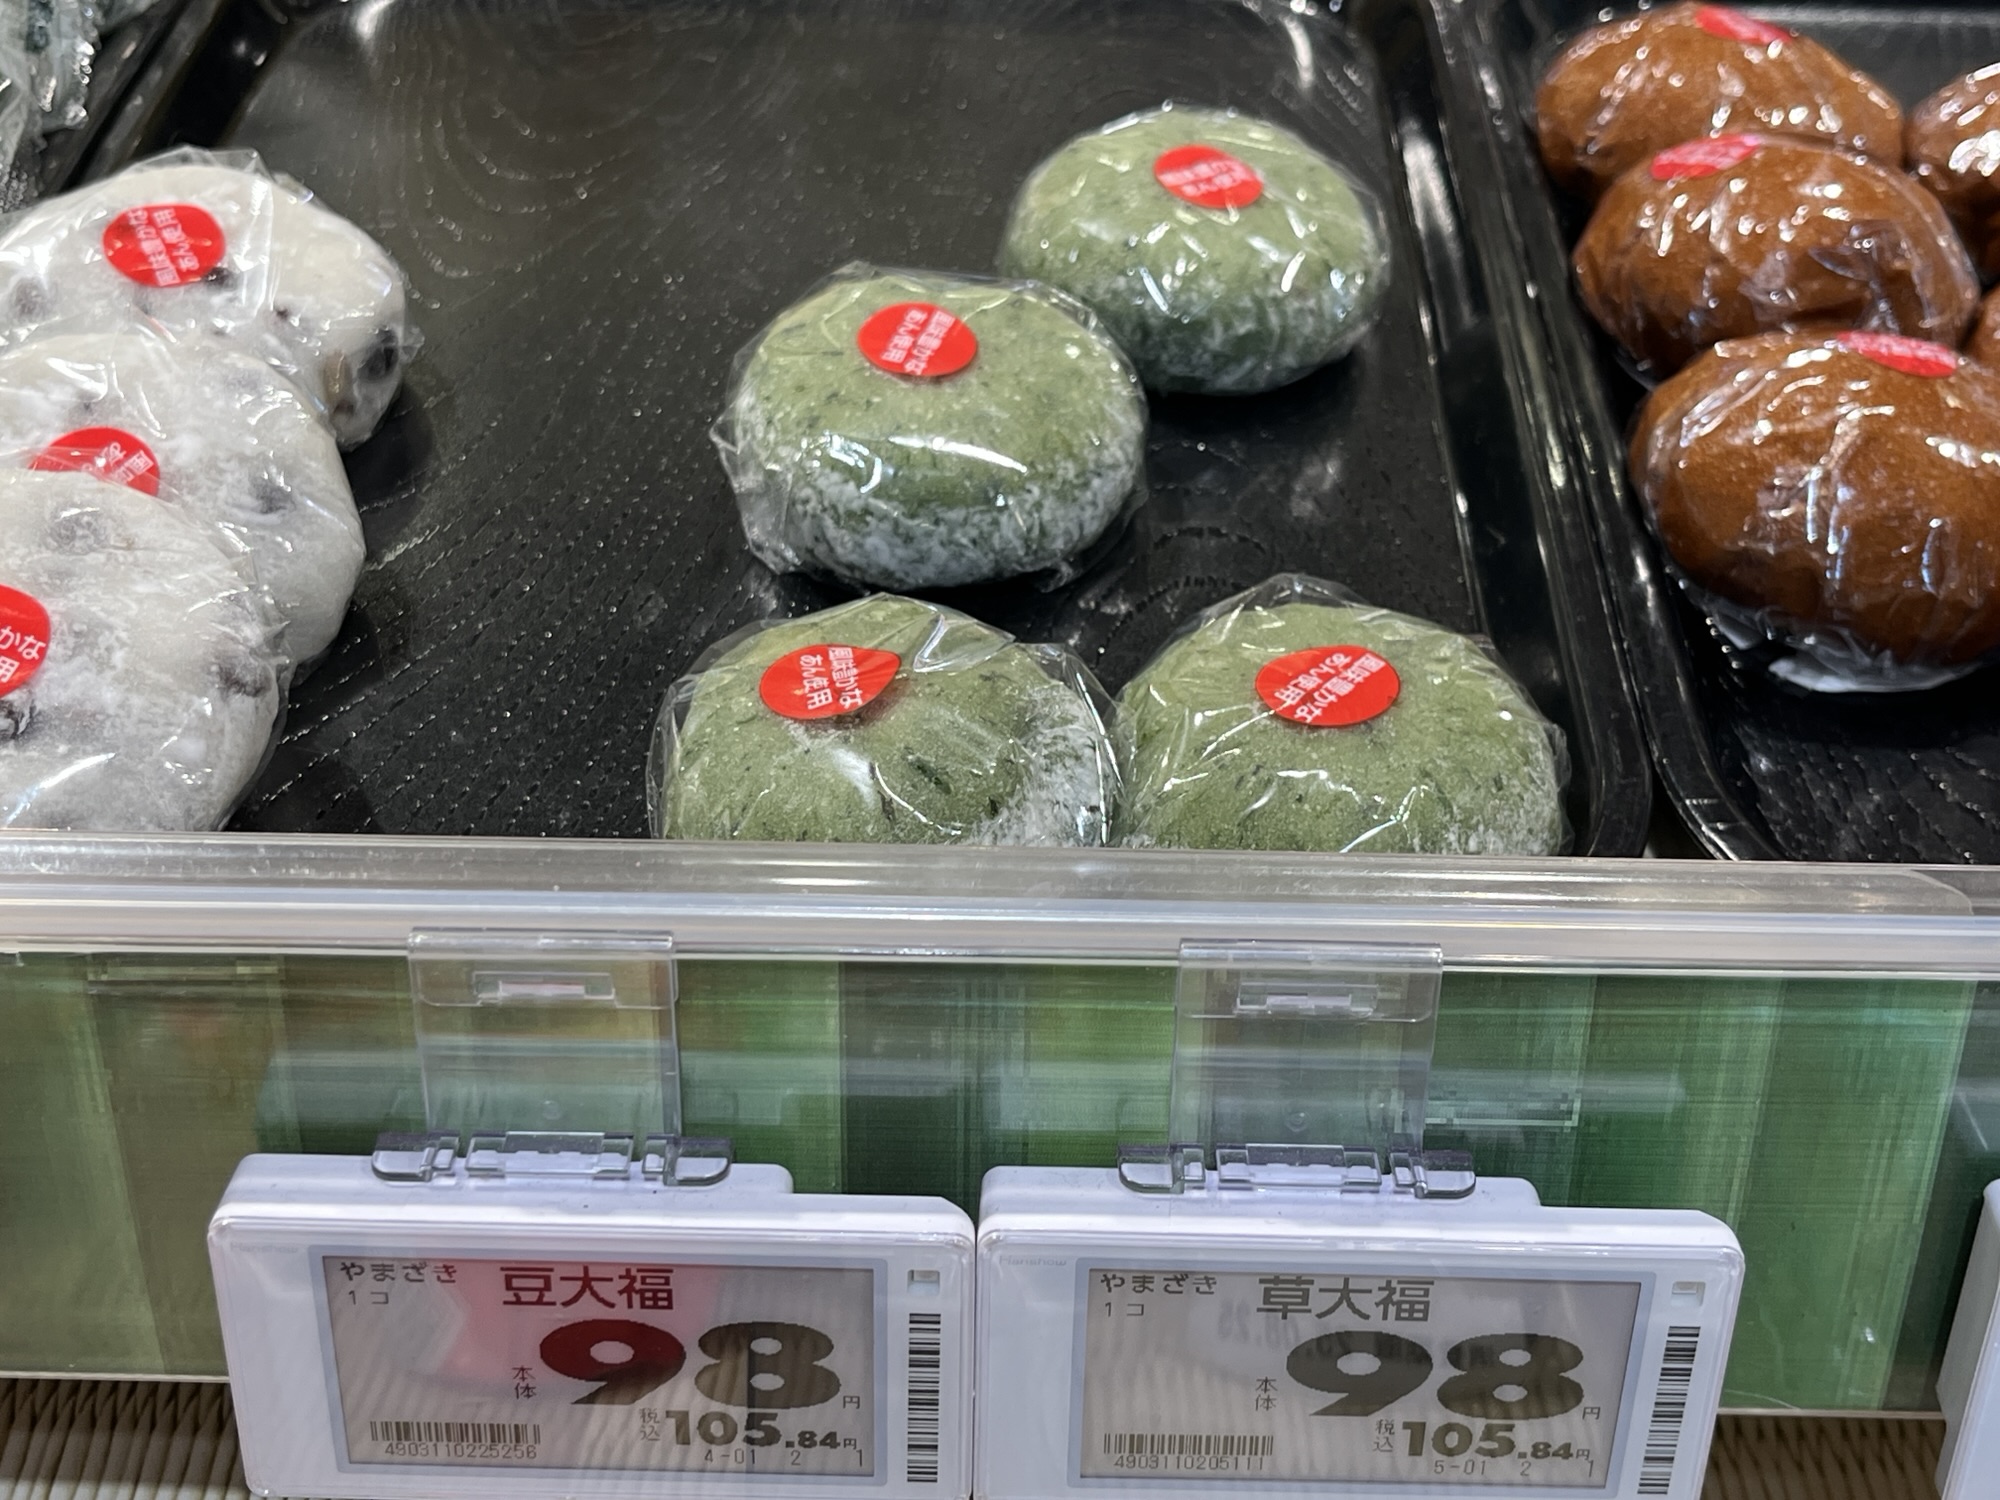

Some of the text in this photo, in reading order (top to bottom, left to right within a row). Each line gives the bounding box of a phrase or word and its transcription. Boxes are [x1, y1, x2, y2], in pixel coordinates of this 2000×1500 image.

[800, 654, 833, 710] あん使用
[1274, 652, 1353, 705] あん使用
[340, 1261, 459, 1285] やまざき
[500, 1266, 675, 1311] 豆大福
[1100, 1273, 1218, 1296] やまざき
[1256, 1275, 1435, 1322] 草大福
[511, 1365, 538, 1399] 本体
[1255, 1376, 1278, 1412] 本体
[639, 1407, 662, 1442] 税込
[1371, 1418, 1396, 1453] 税込
[384, 1442, 538, 1460] 4903110225256
[703, 1450, 757, 1466] 4-01
[789, 1450, 801, 1467] 2
[1113, 1455, 1265, 1471] 4903110205111
[1433, 1459, 1488, 1475] 5-01
[1519, 1459, 1533, 1477] 2
